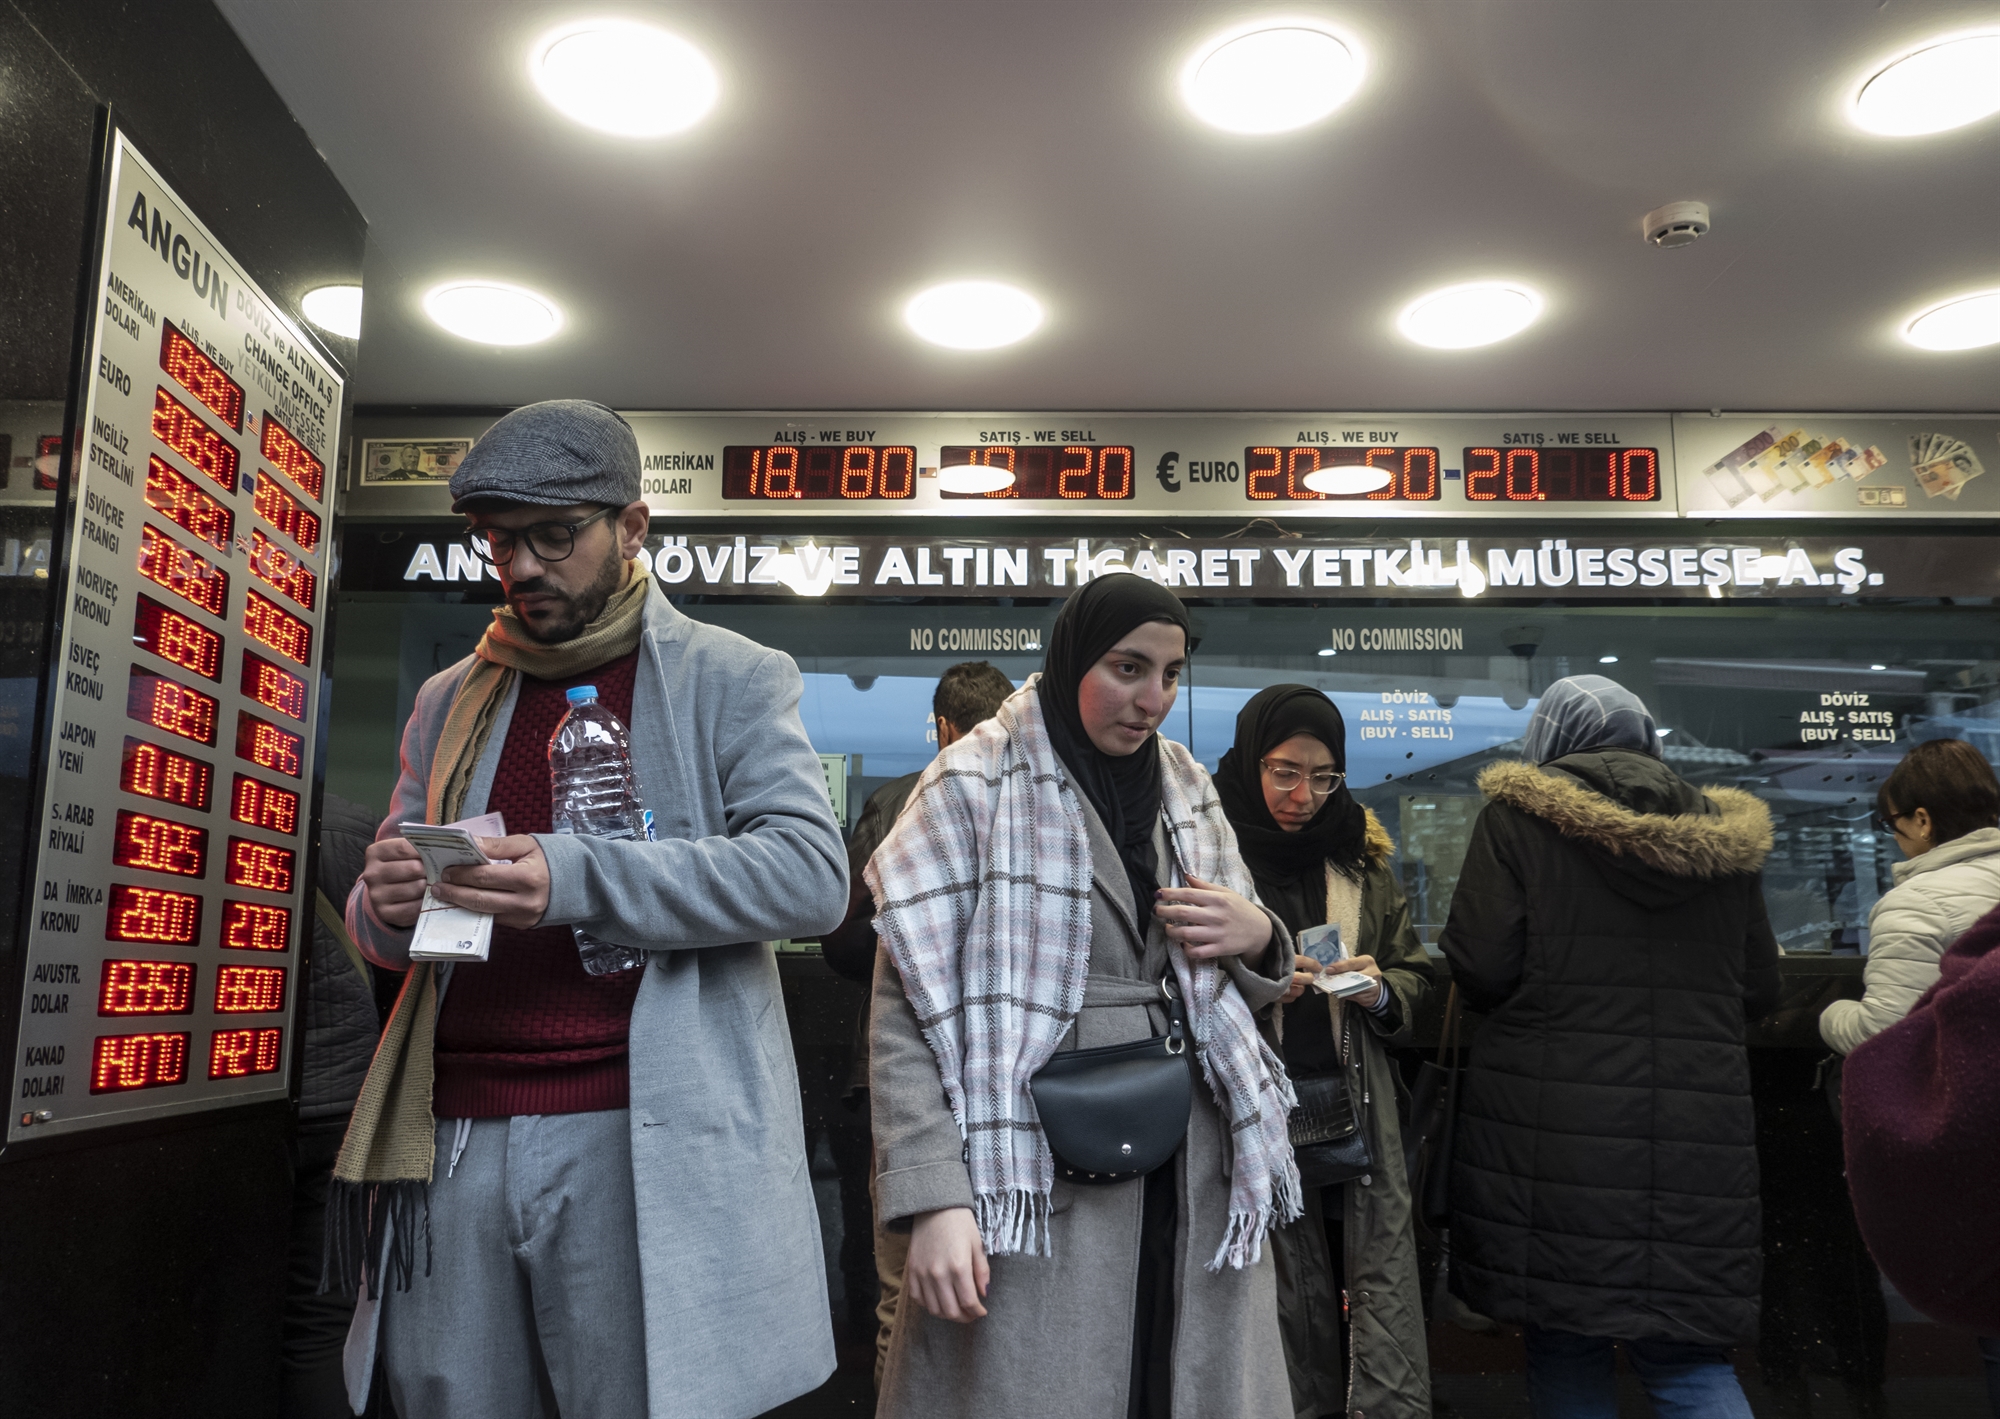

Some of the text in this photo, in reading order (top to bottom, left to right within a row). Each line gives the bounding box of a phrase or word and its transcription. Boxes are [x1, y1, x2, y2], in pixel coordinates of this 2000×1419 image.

[128, 191, 229, 321] ANGUN
[107, 271, 156, 328] AMERİKAN
[105, 296, 140, 341] DOLARI
[181, 318, 199, 345] ALIŞ
[205, 340, 218, 361] WE
[219, 353, 235, 375] BUY
[236, 288, 272, 340] DÖVİZ
[273, 331, 286, 354] ve
[287, 345, 316, 387] ALTIN
[99, 354, 131, 397] EURO
[237, 348, 277, 401] YETKİLİ
[244, 332, 325, 427] CHANGE OFFICE
[296, 427, 306, 443] WE
[306, 437, 320, 456] SELL
[774, 431, 806, 445] ALIŞ
[819, 431, 841, 442] WE
[846, 431, 876, 442] BUY
[979, 431, 1021, 445] SATIŞ
[1034, 431, 1056, 442] WE
[1061, 431, 1096, 442] SELL
[1297, 431, 1329, 445] ALIŞ
[1342, 432, 1364, 442] WE
[1369, 432, 1399, 442] BUY
[1503, 433, 1545, 447] SATIŞ
[1557, 433, 1580, 444] WE
[1584, 433, 1620, 444] SELL
[90, 443, 134, 487] STERLİNİ
[643, 451, 714, 471] AMERİKAN
[1189, 460, 1239, 483] EURO
[643, 478, 692, 495] DOLARI
[85, 485, 124, 529] İSVİÇRE
[82, 517, 119, 554] FRANGI
[637, 536, 779, 584] ÖVİZ
[794, 546, 860, 584] VE
[874, 547, 1028, 585] ALTIN
[1044, 538, 1261, 586] TİCARET
[1273, 540, 1470, 586] YETKİLİ
[1488, 540, 1764, 586] MÜESSESE
[1777, 548, 1885, 594] A.Ş.
[77, 565, 118, 606] NORVEÇ
[74, 593, 111, 627] KRONU
[910, 628, 1041, 651] NO COMMISSION
[1332, 628, 1463, 650] NO COMMISSION
[68, 637, 100, 675] İSVEÇ
[66, 670, 103, 701] KRONU
[1381, 689, 1429, 704] DÖVİZ
[1820, 691, 1869, 706] DÖVİZ
[1360, 709, 1394, 724] ALIŞ
[1408, 709, 1452, 724] SATIŞ
[1800, 711, 1835, 726] ALIŞ
[1848, 711, 1893, 727] SATIŞ
[60, 721, 96, 749] JAPON
[1360, 727, 1397, 740] (BUY
[1411, 727, 1454, 740] SELL)
[1801, 728, 1839, 742] (BUY
[1852, 728, 1896, 743] SELL)
[59, 749, 84, 774] YENİ
[51, 803, 94, 827] S. ARAB
[49, 826, 84, 854] RİYALİ
[40, 911, 80, 934] KRONU
[32, 964, 81, 984] AVUSTR.
[31, 994, 69, 1014] DOLAR
[25, 1045, 65, 1067] KANAD
[22, 1075, 65, 1098] DOLARI
